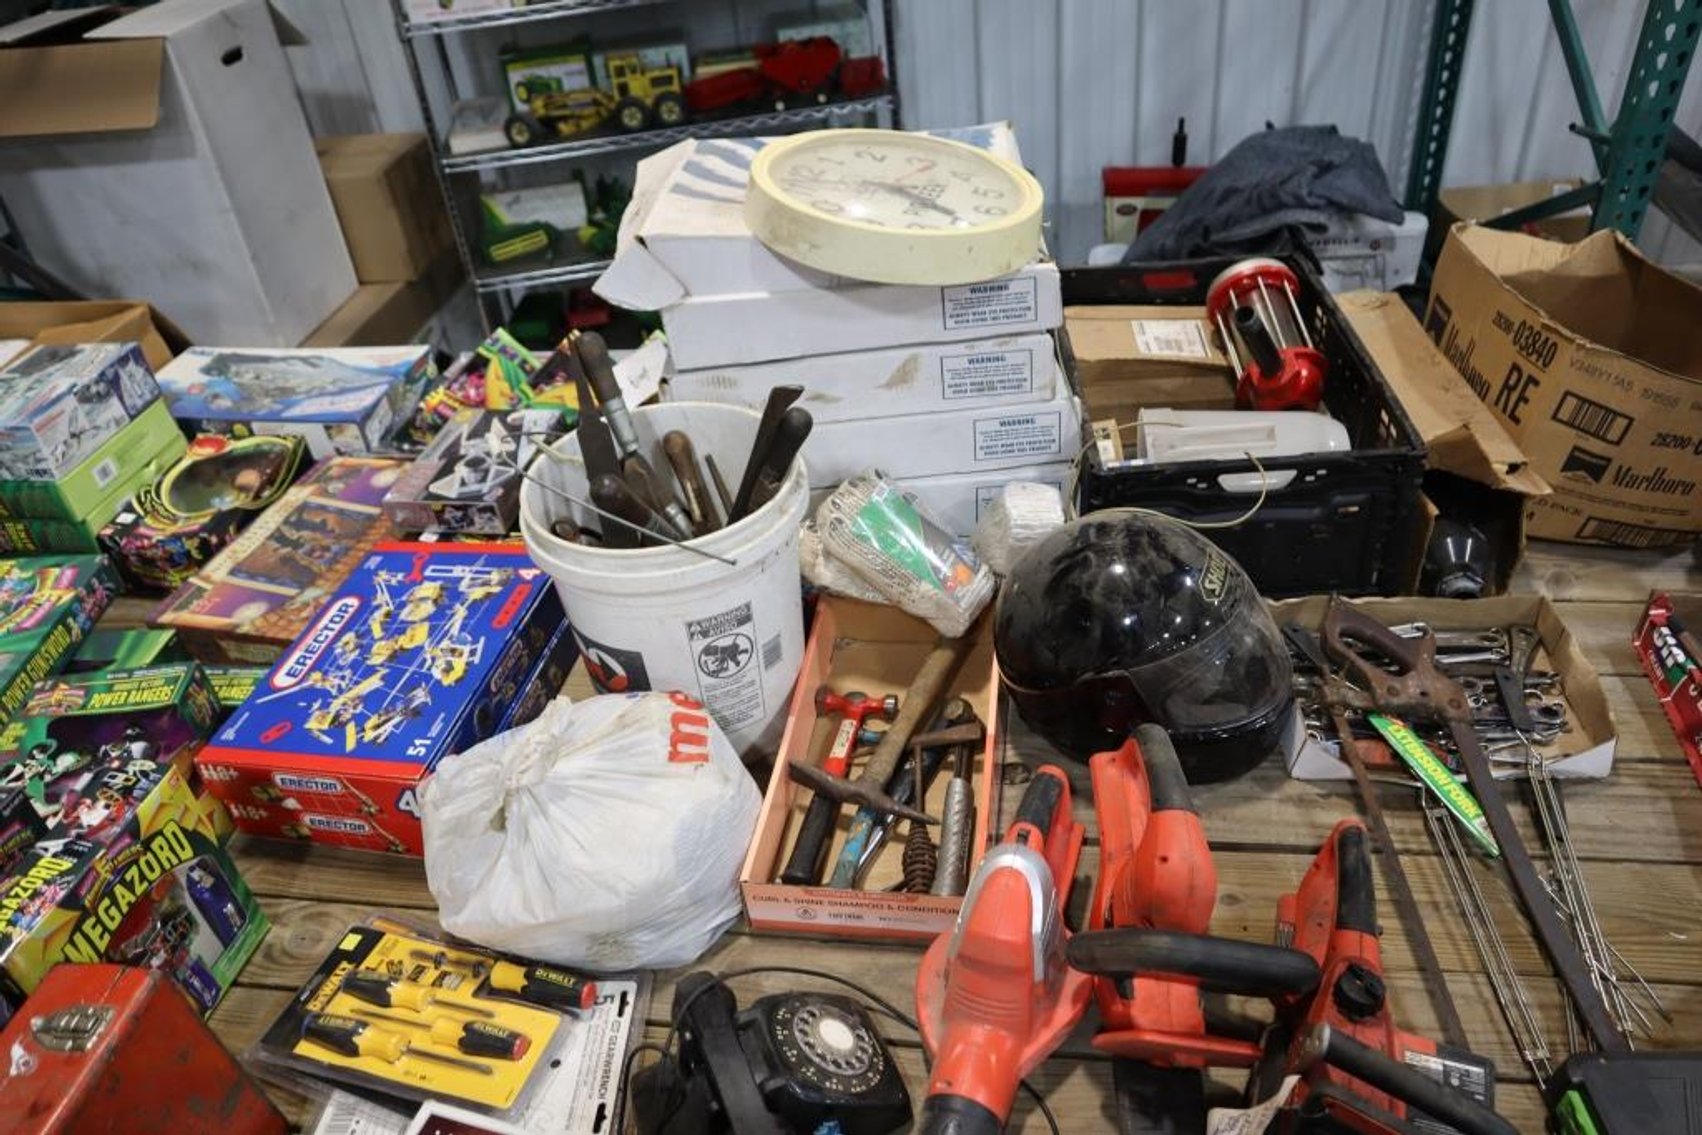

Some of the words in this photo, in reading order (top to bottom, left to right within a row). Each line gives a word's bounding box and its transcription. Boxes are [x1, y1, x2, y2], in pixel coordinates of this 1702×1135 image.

[970, 284, 1010, 294] WARNING
[967, 355, 1007, 365] WARNING
[1494, 361, 1541, 426] RE
[999, 418, 1036, 427] WARNING
[1612, 465, 1696, 495] Marlboro
[518, 568, 542, 580] 4
[286, 600, 355, 680] ERECTOR
[88, 691, 128, 709] POWER
[127, 685, 174, 703] RANGERS
[406, 738, 432, 757] 51
[1389, 720, 1452, 787] EXTENSION
[1447, 780, 1484, 819] FORK
[280, 777, 338, 791] ERECTOR
[309, 817, 366, 832] ERECTOR
[63, 819, 194, 963] MEGAZORD
[534, 968, 577, 987] DEWALT
[598, 1034, 618, 1100] GEARWRENCH
